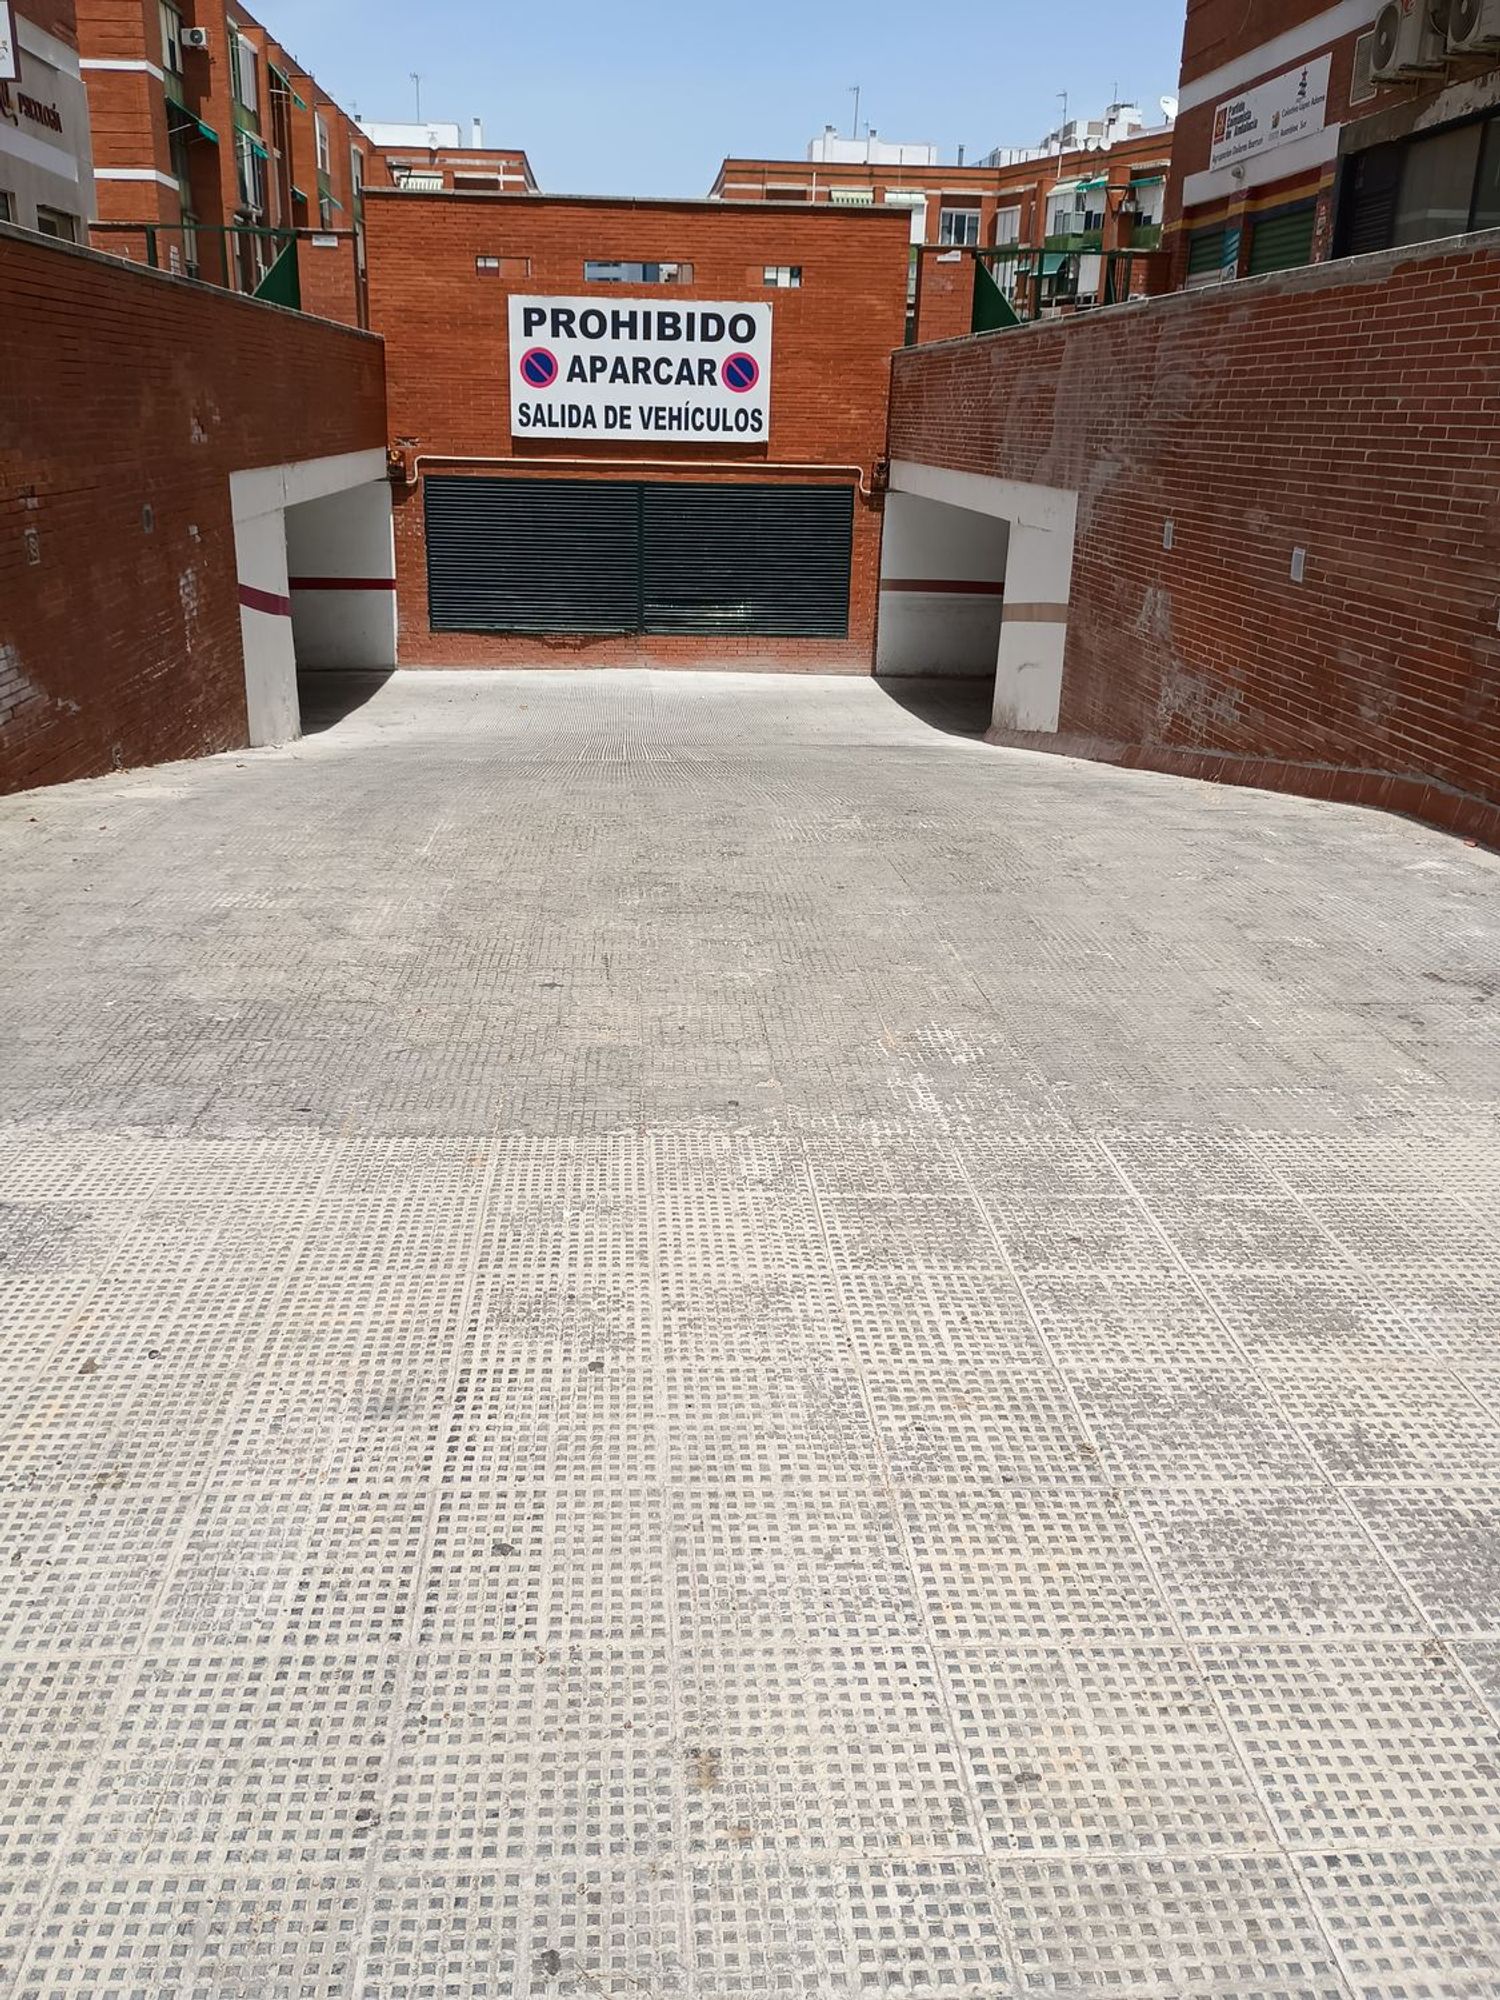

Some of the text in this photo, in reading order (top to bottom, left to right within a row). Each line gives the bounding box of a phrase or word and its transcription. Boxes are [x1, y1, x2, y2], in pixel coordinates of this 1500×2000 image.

[523, 307, 757, 344] PROHIBIDO
[566, 355, 718, 387] APARCAR
[518, 401, 763, 432] SALIDA DE VEHÍCULOS
